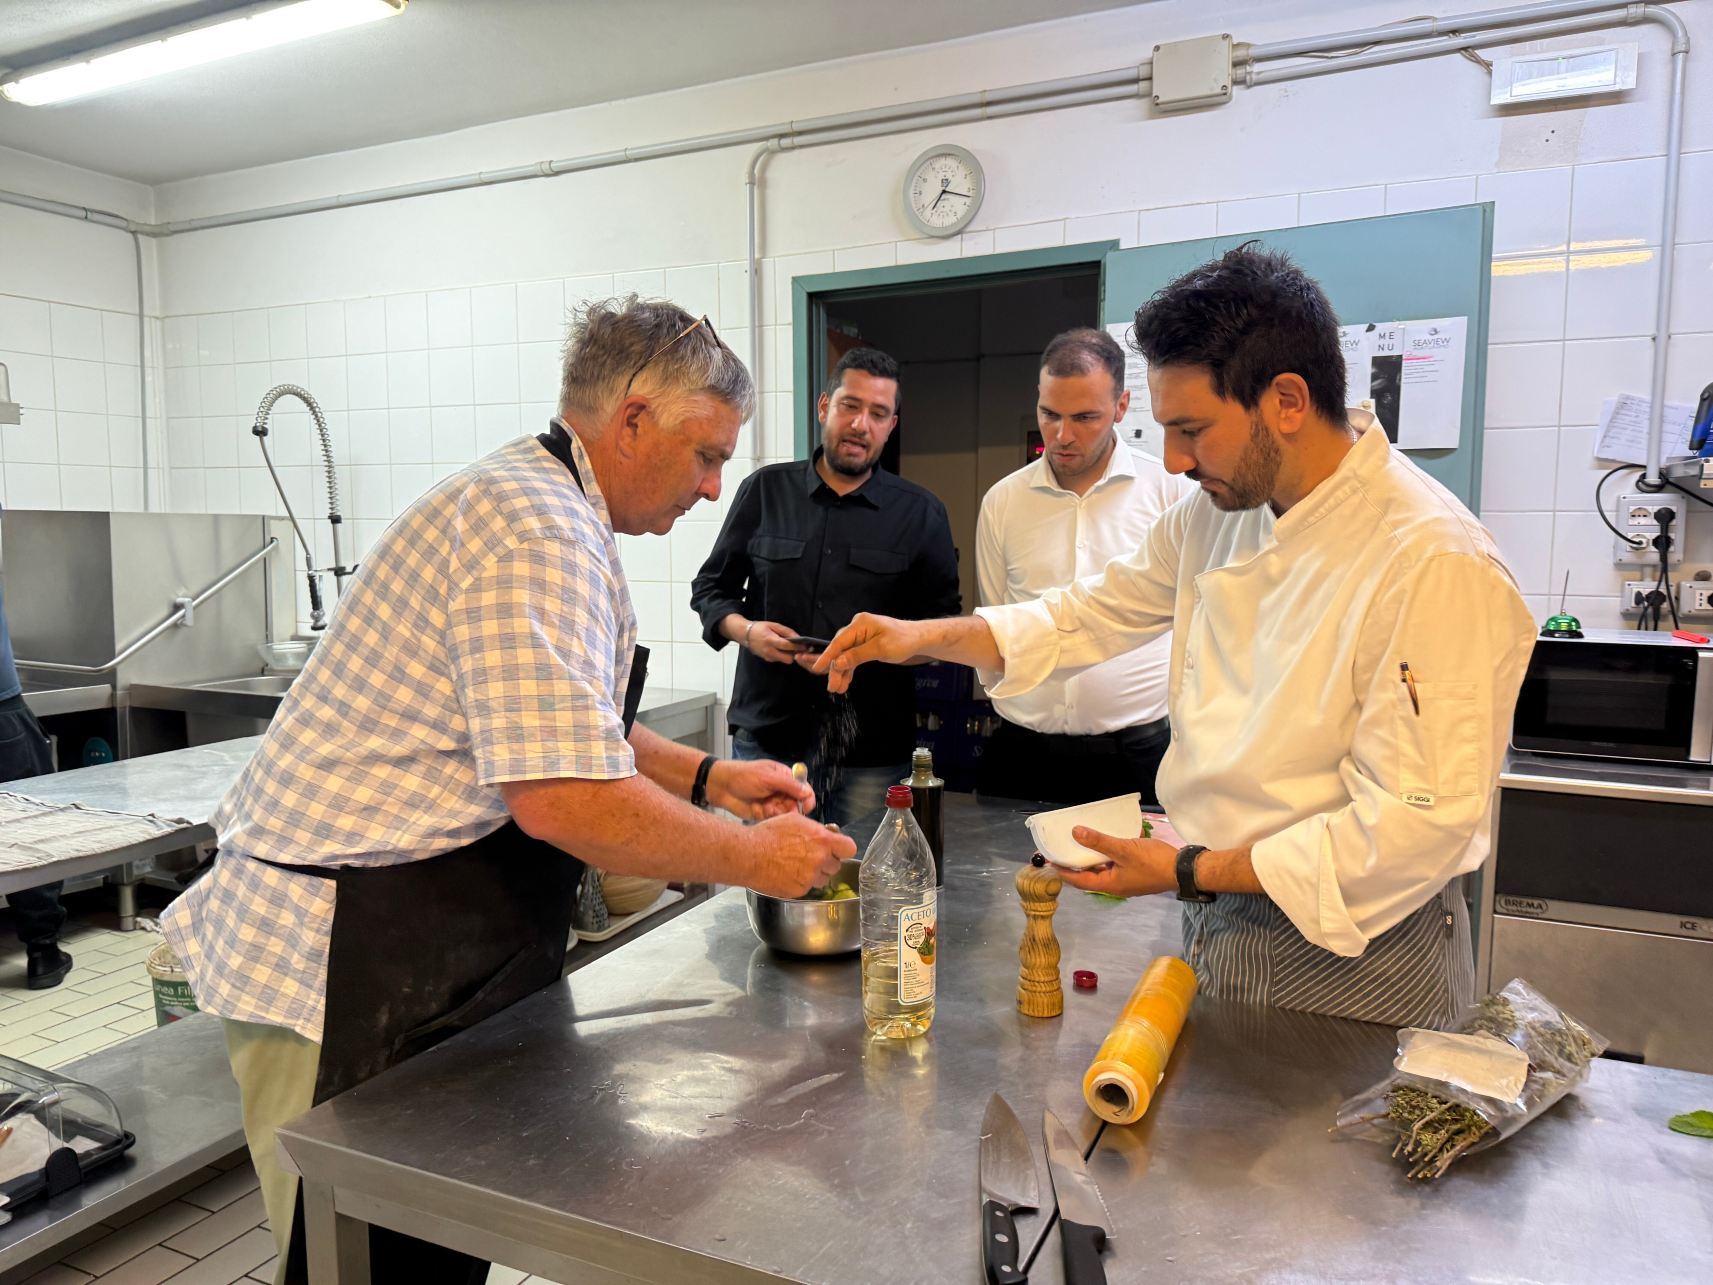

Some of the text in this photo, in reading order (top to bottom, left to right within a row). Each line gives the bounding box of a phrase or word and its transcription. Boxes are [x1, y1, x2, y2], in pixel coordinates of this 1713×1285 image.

[1412, 337, 1452, 347] SEAVIEW
[1504, 898, 1544, 910] BREMA
[904, 908, 932, 921] ACETO
[1679, 920, 1698, 930] ICE
